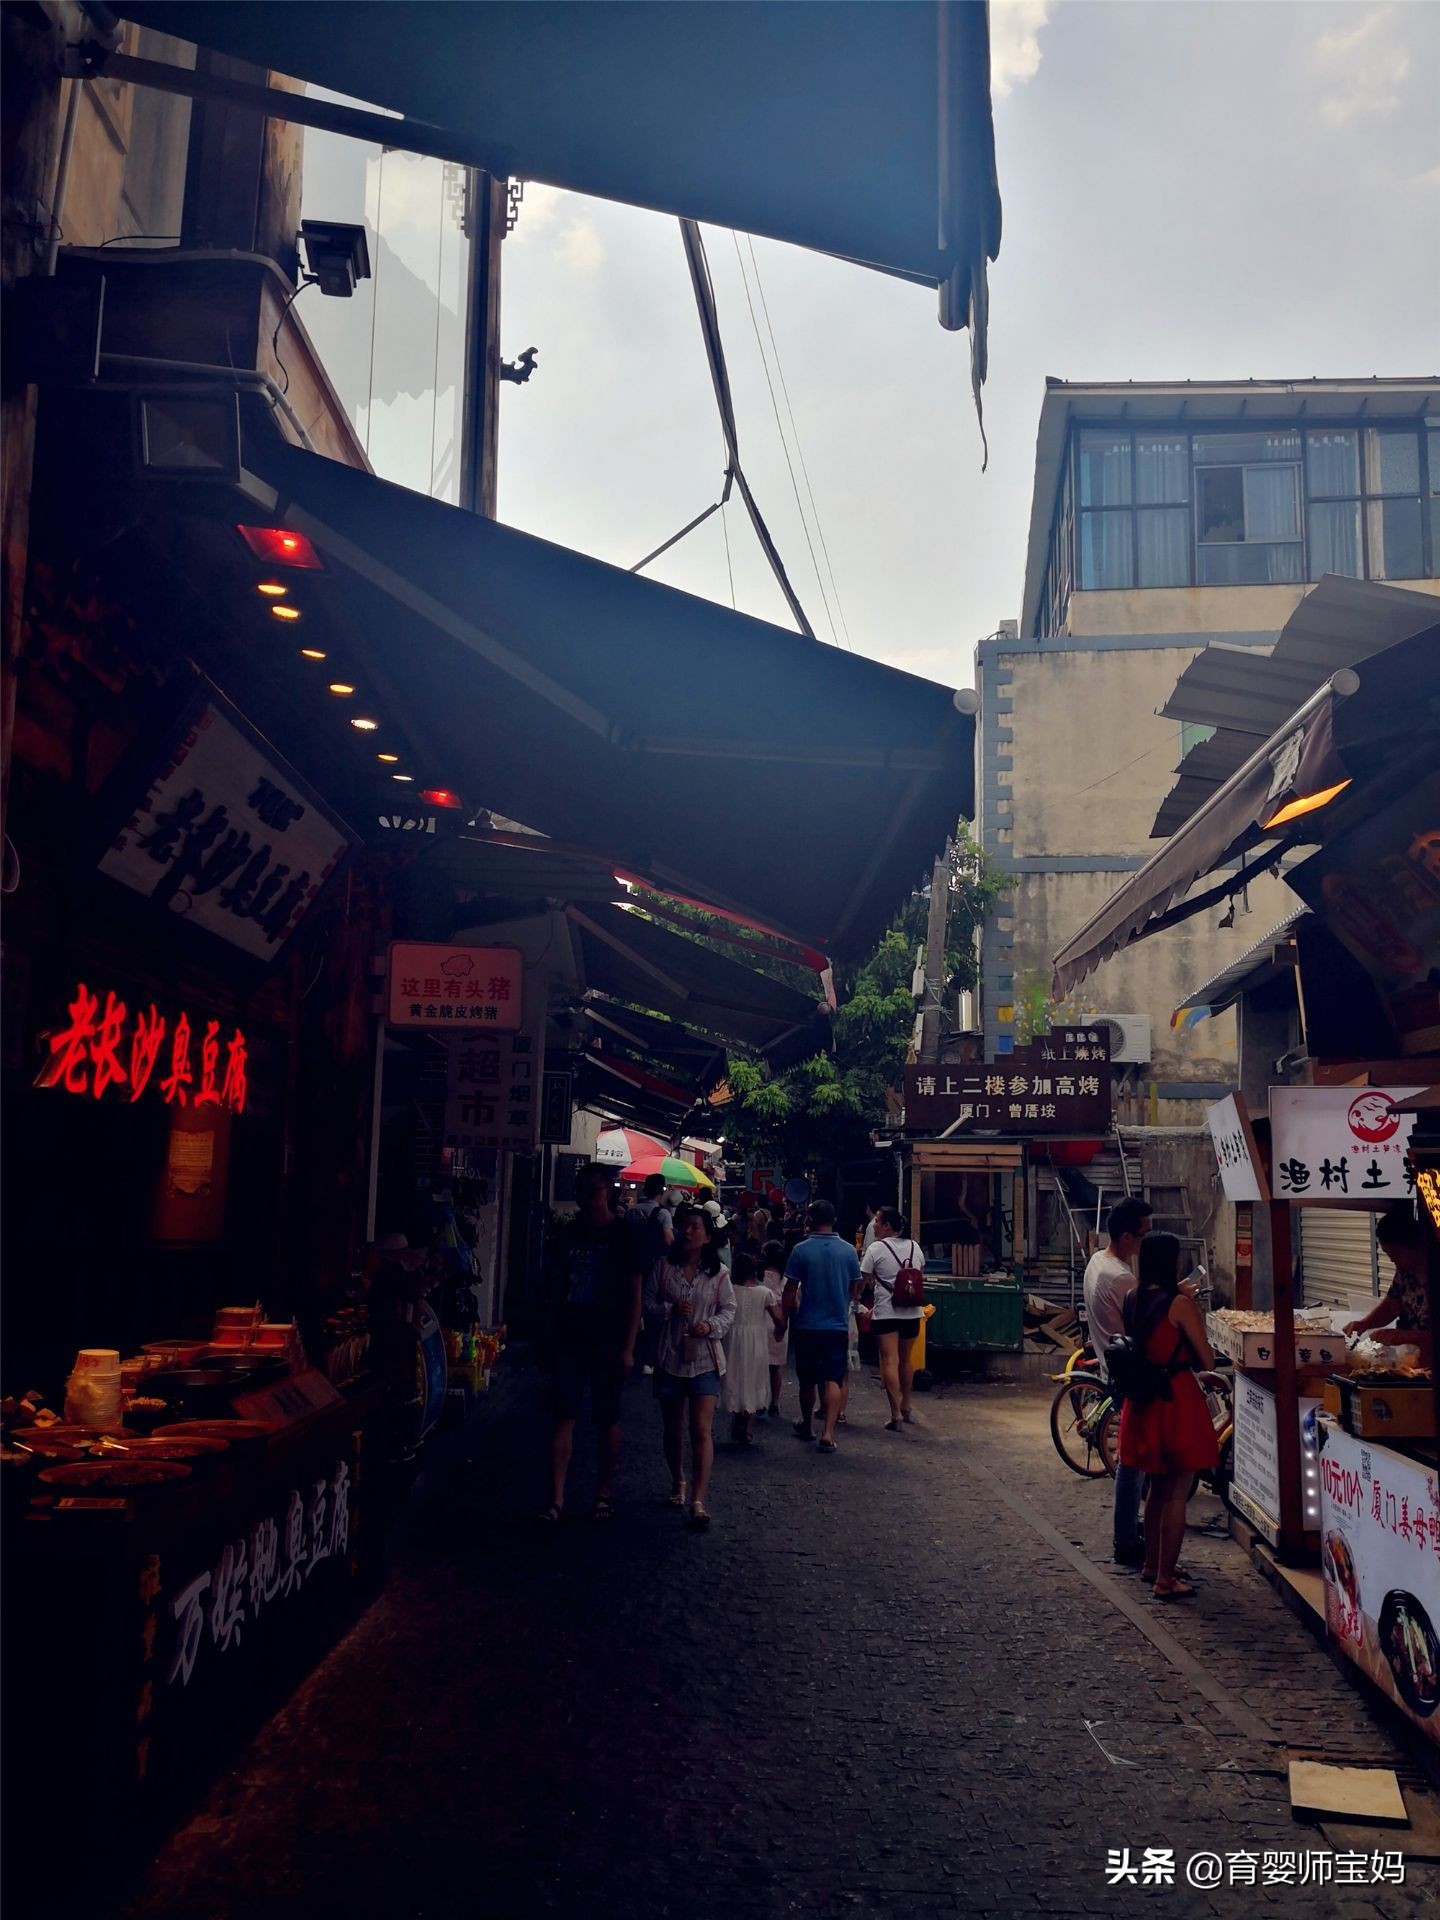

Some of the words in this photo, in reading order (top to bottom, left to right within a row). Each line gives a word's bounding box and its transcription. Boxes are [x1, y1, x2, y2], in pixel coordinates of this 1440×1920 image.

[401, 976, 511, 1000] 这里有头猪
[409, 1003, 498, 1019] 黄金脆皮烤猪
[49, 982, 249, 1116] 老长沙臭豆腐
[1041, 1046, 1107, 1061] 纸上烧烤
[456, 1033, 501, 1126] 超市
[916, 1075, 1100, 1096] 请上二楼参加高烤
[1321, 1457, 1364, 1517] 10元10个
